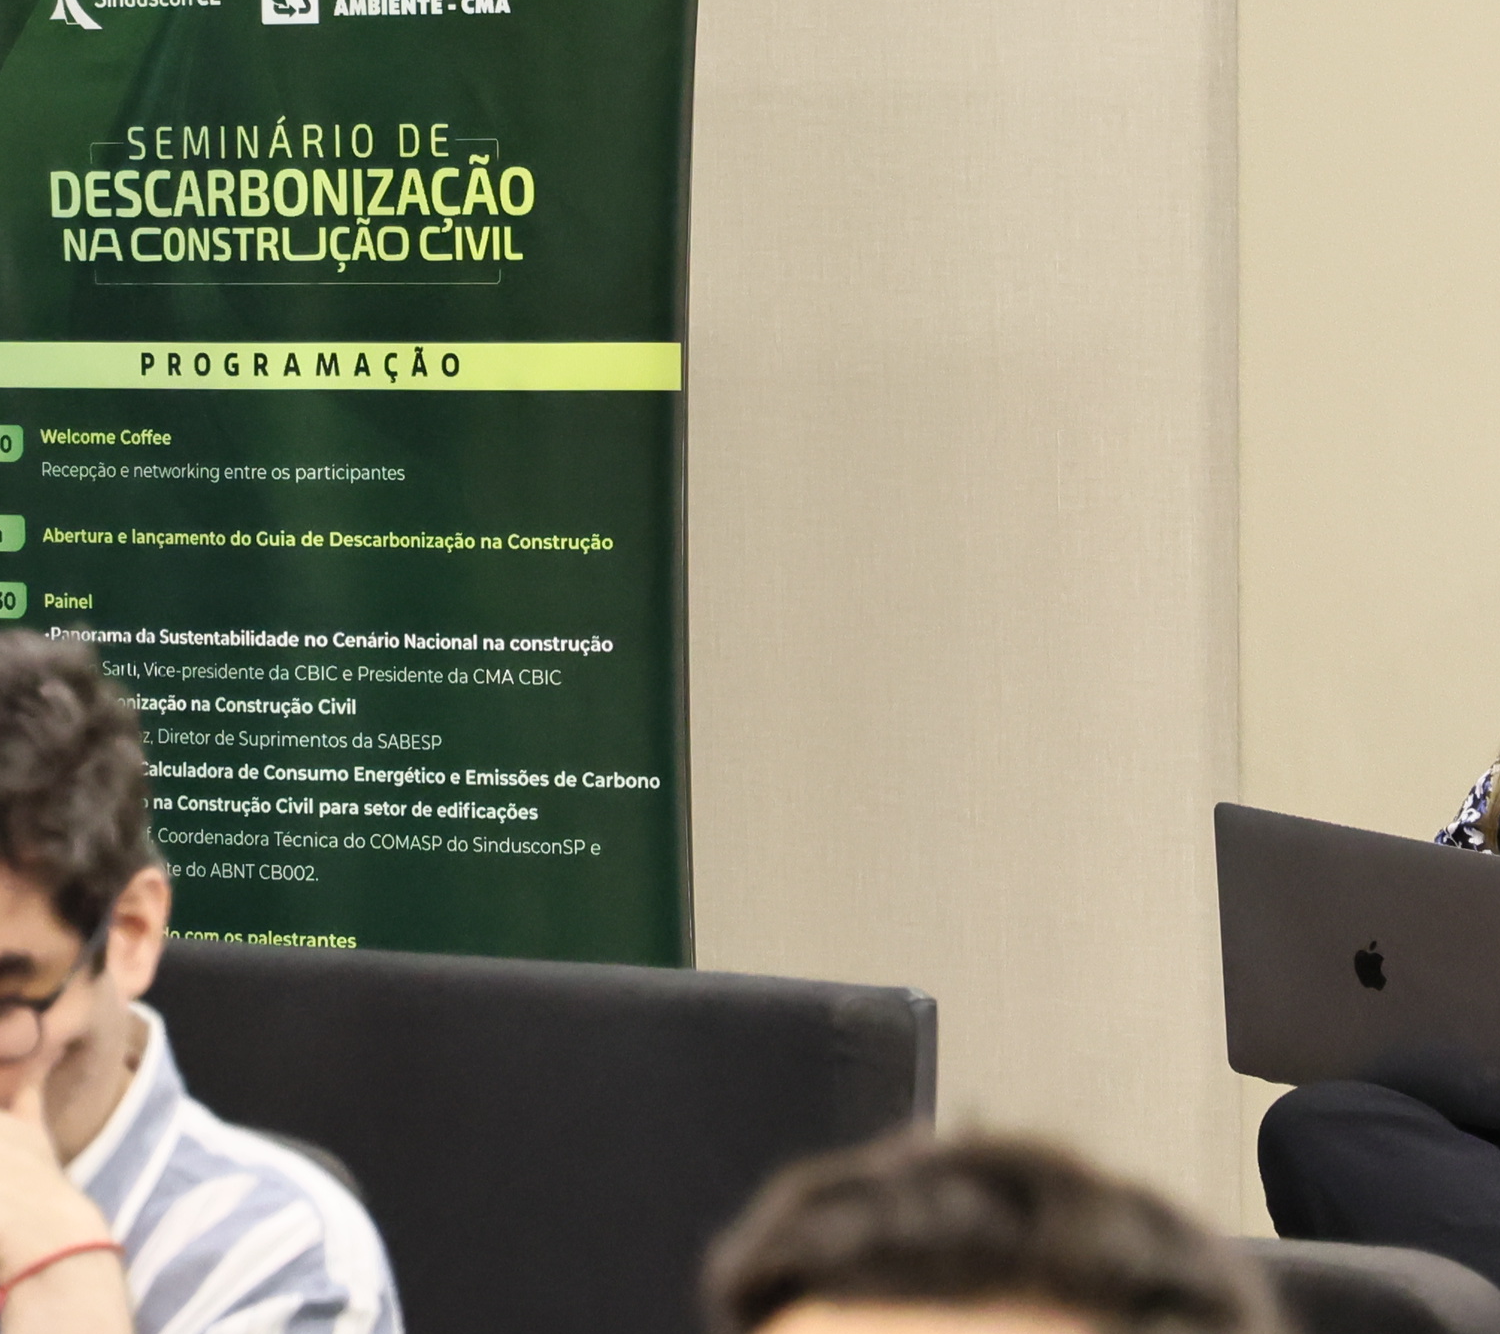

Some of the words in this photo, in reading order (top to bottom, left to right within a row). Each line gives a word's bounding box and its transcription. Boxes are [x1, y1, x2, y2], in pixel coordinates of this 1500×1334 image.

[127, 115, 374, 161] SEMINÁRIO
[398, 123, 450, 158] DE
[49, 153, 535, 232] DESCARBONIZAÇÃO
[63, 227, 124, 262] NA
[130, 215, 410, 273] CONSTRUÇÃO
[140, 346, 460, 384] PROGRAMAÇÃO
[40, 428, 116, 445] Welcome
[120, 428, 172, 446] Coffee
[41, 461, 117, 482] Recepção
[120, 465, 130, 478] e
[133, 462, 220, 484] networking
[223, 465, 268, 480] entre
[271, 467, 291, 480] os
[295, 463, 406, 484] participantes
[42, 527, 114, 544] Abertura
[117, 531, 128, 544] e
[131, 528, 226, 549] lançamento
[230, 529, 252, 547] do
[256, 529, 296, 547] Guia
[300, 530, 325, 547] de
[329, 531, 476, 554] Descarbonização
[480, 536, 503, 550] na
[507, 533, 614, 555] Construção
[44, 592, 93, 610] Painel
[135, 627, 156, 644] da
[159, 628, 300, 648] Sustentabilidade
[304, 634, 329, 648] no
[332, 631, 400, 649] Cenário
[403, 632, 478, 651] Nacional
[482, 637, 505, 651] na
[509, 635, 614, 657] construção
[102, 660, 141, 680] Sarti,
[143, 661, 265, 682] Vice-presidente
[268, 664, 290, 681] da
[294, 664, 338, 682] CBIC
[342, 668, 353, 682] e
[357, 665, 444, 684] Presidente
[447, 667, 469, 685] da
[472, 668, 515, 685] CMA
[518, 668, 562, 686] CBIC
[190, 698, 211, 712] na
[214, 696, 314, 719] Construção
[317, 697, 357, 715] Civil
[158, 728, 211, 745] Diretor
[214, 729, 235, 746] de
[238, 730, 348, 750] Suprimentos
[351, 731, 373, 749] da
[377, 733, 443, 751] SABESP
[237, 763, 260, 780] de
[263, 764, 349, 782] Consumo
[353, 766, 446, 787] Energético
[449, 772, 461, 785] e
[465, 768, 550, 787] Emissões
[553, 770, 578, 788] de
[581, 771, 661, 790] Carbono
[153, 797, 173, 810] na
[176, 794, 272, 818] Construção
[275, 796, 314, 815] Civil
[319, 801, 359, 819] para
[363, 801, 408, 817] setor
[411, 800, 433, 818] de
[436, 801, 539, 825] edificações
[157, 827, 270, 847] Coordenadora
[273, 831, 339, 849] Técnica
[343, 832, 366, 849] do
[369, 833, 443, 851] COMASP
[446, 835, 469, 852] do
[472, 836, 586, 855] SindusconSP
[590, 842, 601, 856] e
[185, 861, 207, 878] do
[209, 862, 256, 879] ABNT
[258, 863, 319, 882] CB002.
[247, 930, 357, 949] palestrantes
